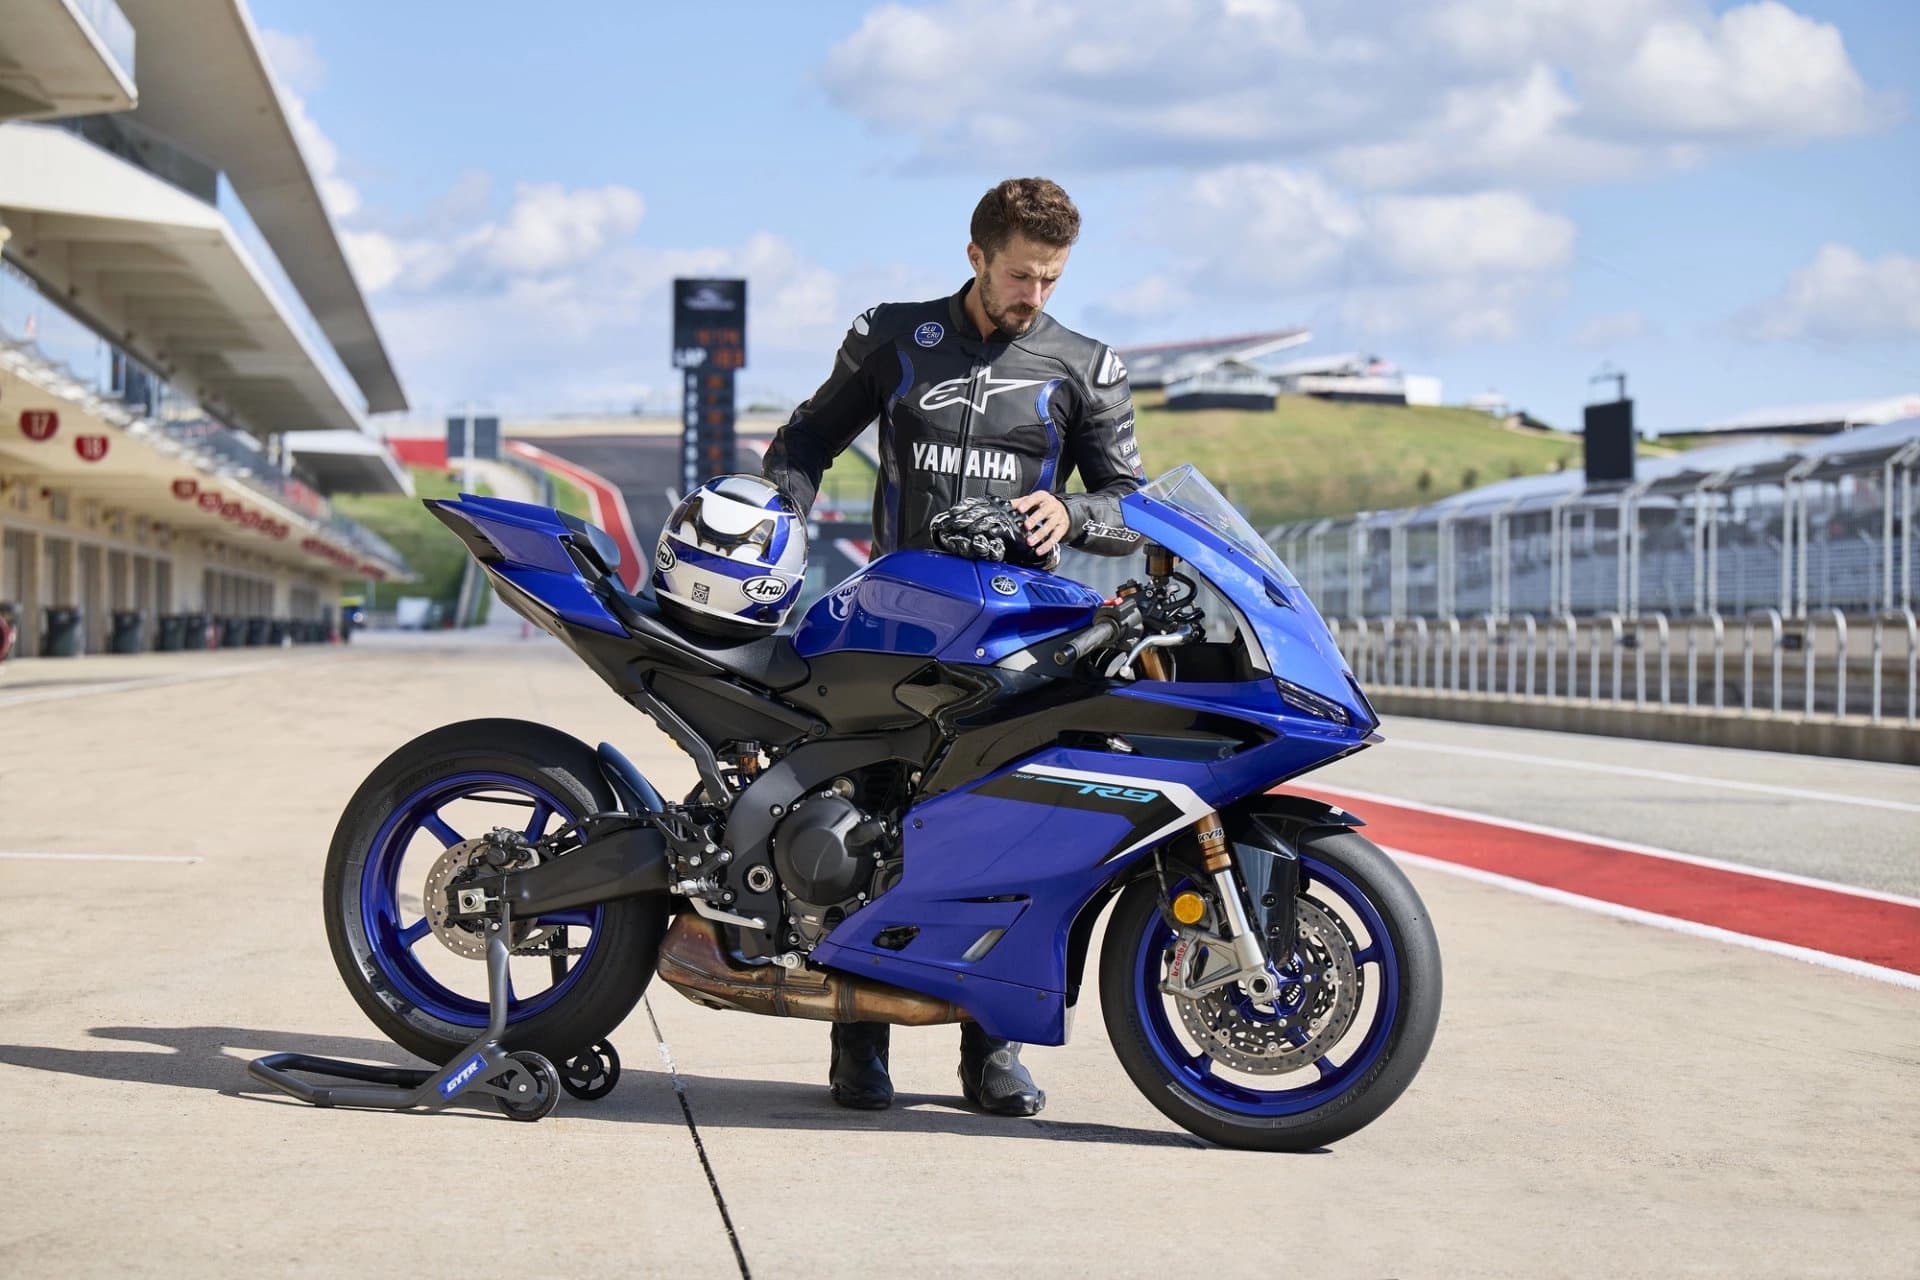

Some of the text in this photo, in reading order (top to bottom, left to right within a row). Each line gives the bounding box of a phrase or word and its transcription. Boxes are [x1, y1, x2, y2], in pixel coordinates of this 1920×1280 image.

[31, 413, 51, 438] 17
[912, 442, 1016, 481] YAMAHA
[744, 580, 784, 596] Arai
[1198, 827, 1225, 844] KYB
[1170, 942, 1187, 977] brembo
[446, 1060, 479, 1092] GYTR
